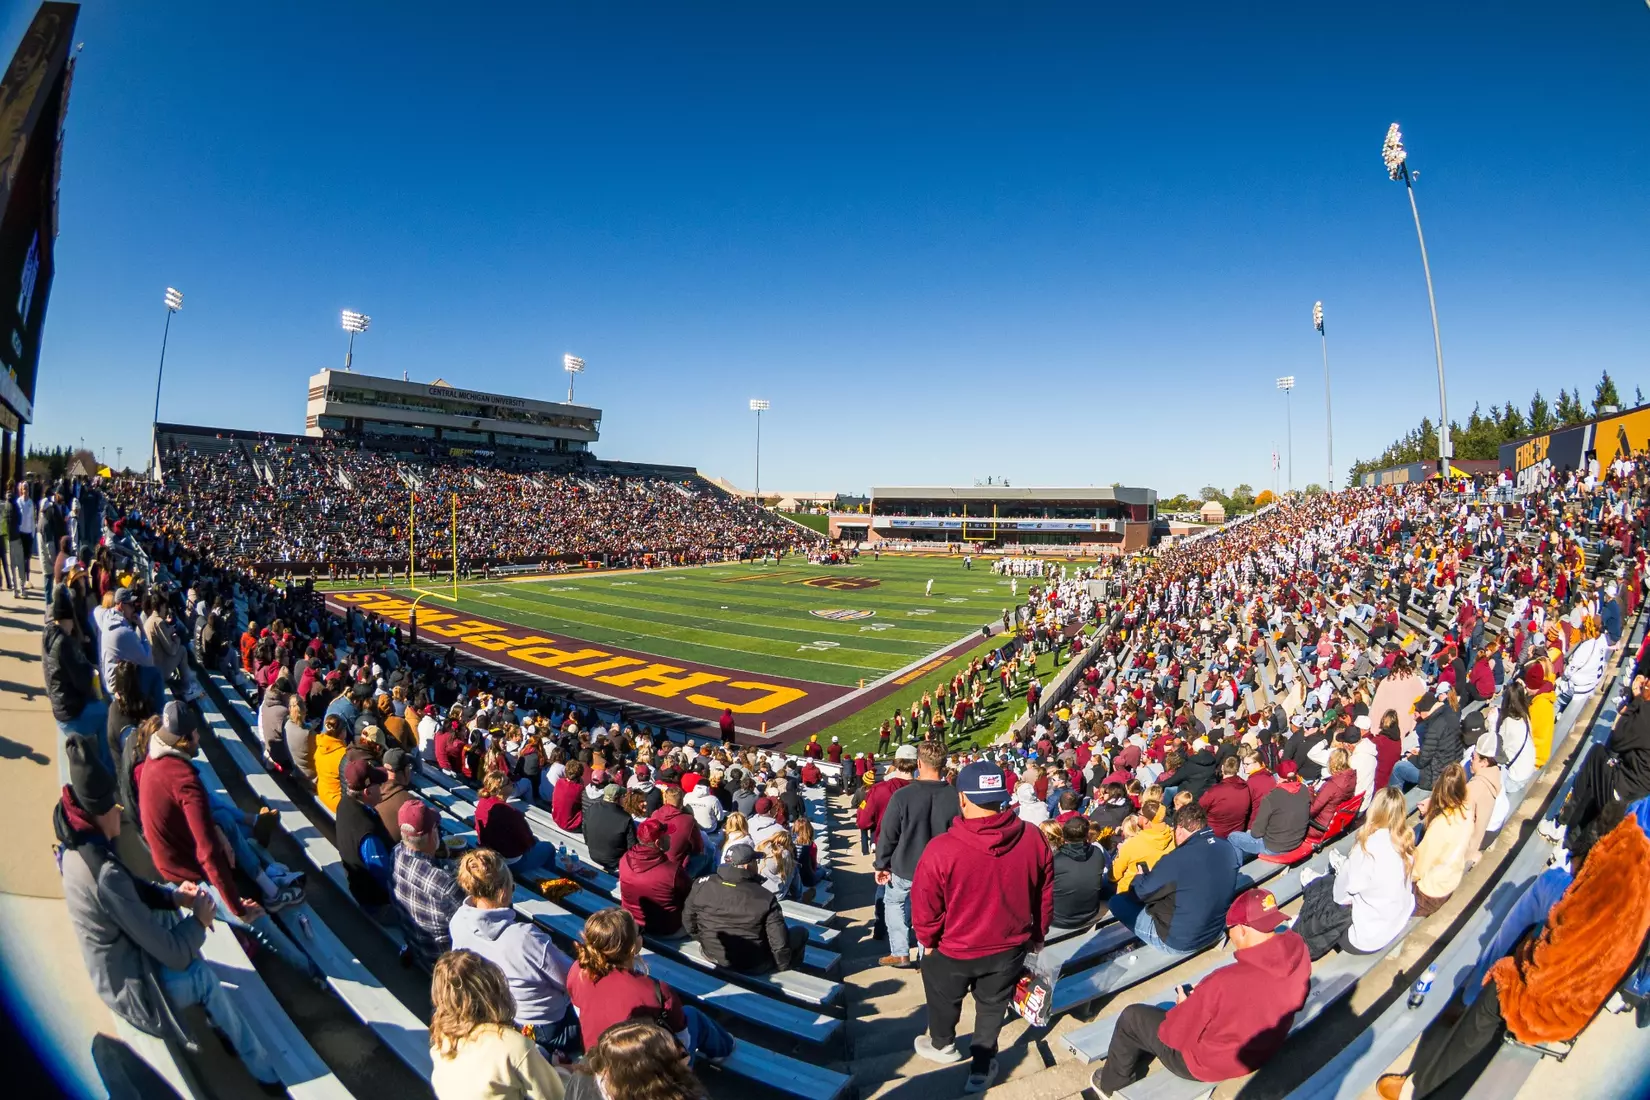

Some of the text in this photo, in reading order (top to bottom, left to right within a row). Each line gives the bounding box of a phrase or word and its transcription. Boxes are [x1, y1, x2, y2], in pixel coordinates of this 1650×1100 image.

[429, 388, 526, 408] CENTRAL MICHIGAN UNIVERSITY
[1516, 439, 1535, 472] FIRE
[333, 592, 809, 714] CHIPPEWAS
